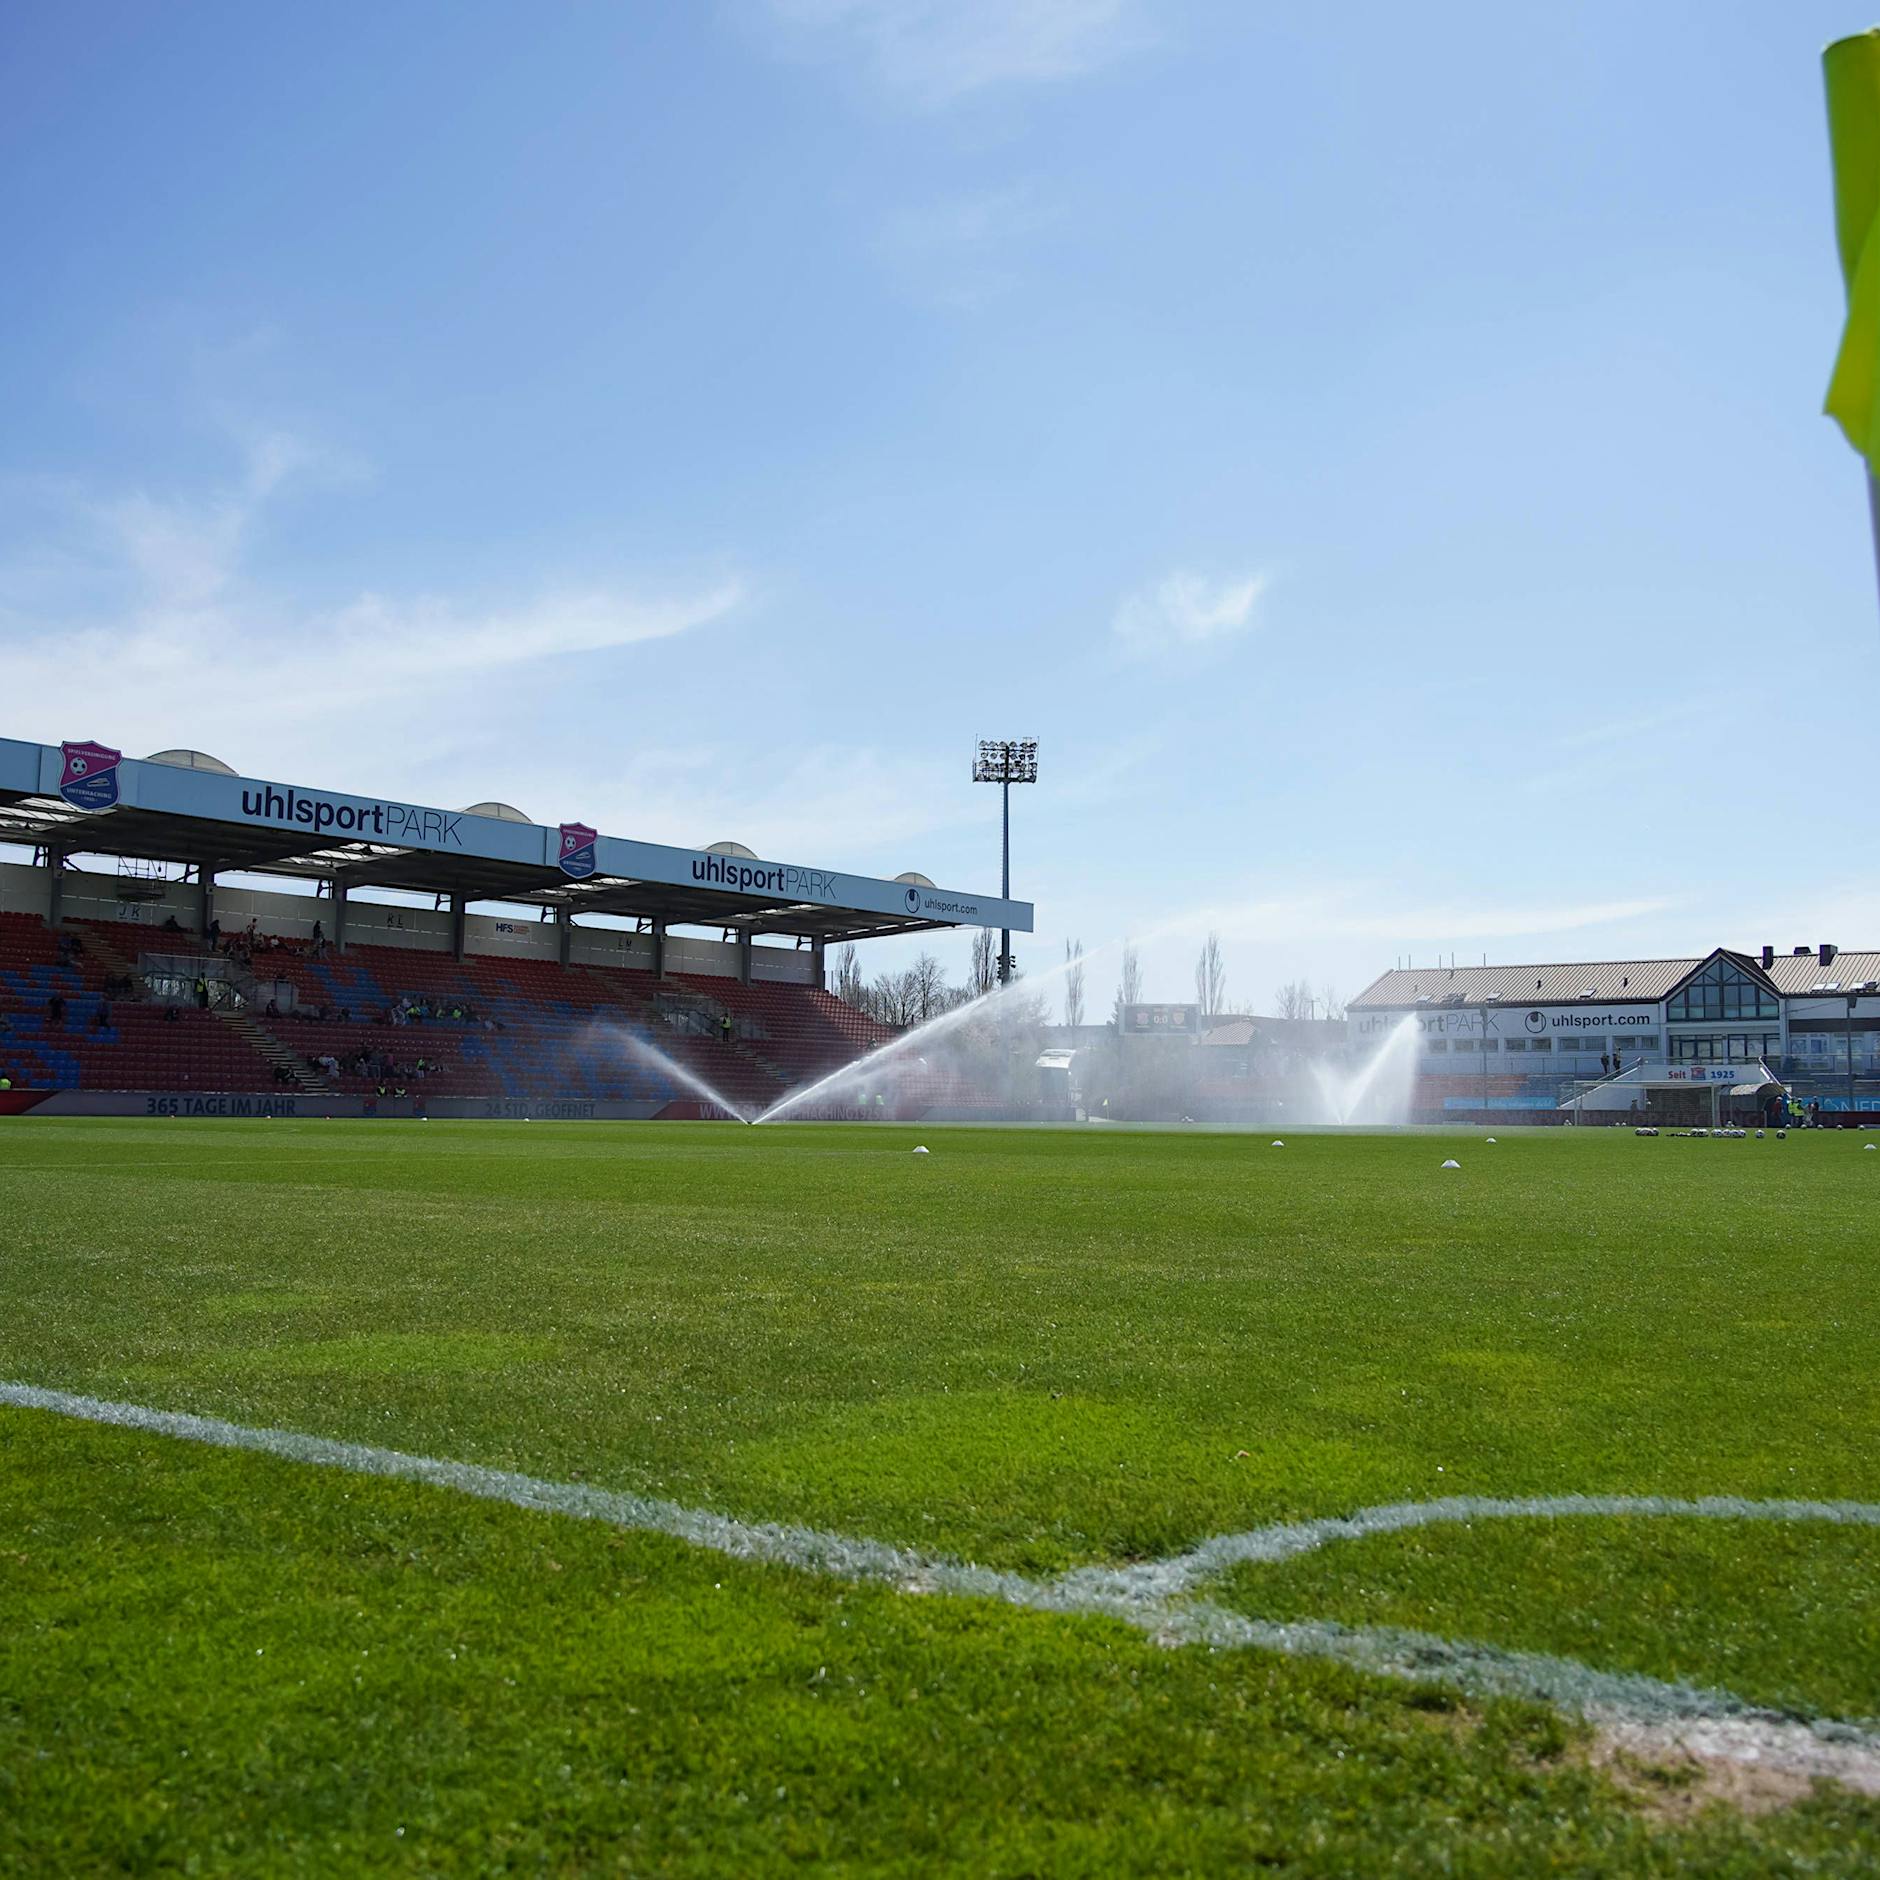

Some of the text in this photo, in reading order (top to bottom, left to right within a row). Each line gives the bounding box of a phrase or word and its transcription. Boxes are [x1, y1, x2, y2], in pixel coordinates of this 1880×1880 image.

[242, 786, 462, 846] uhlsportPARK
[692, 856, 837, 899] uhlsportPARK
[924, 898, 978, 916] uhlsport.com
[496, 922, 513, 934] HFS
[1153, 1015, 1169, 1024] 0:0
[1551, 1013, 1651, 1030] uhlsport.com
[1668, 1070, 1735, 1080] Seit 1925
[147, 1098, 296, 1115] 365 TAGE IM JAHR
